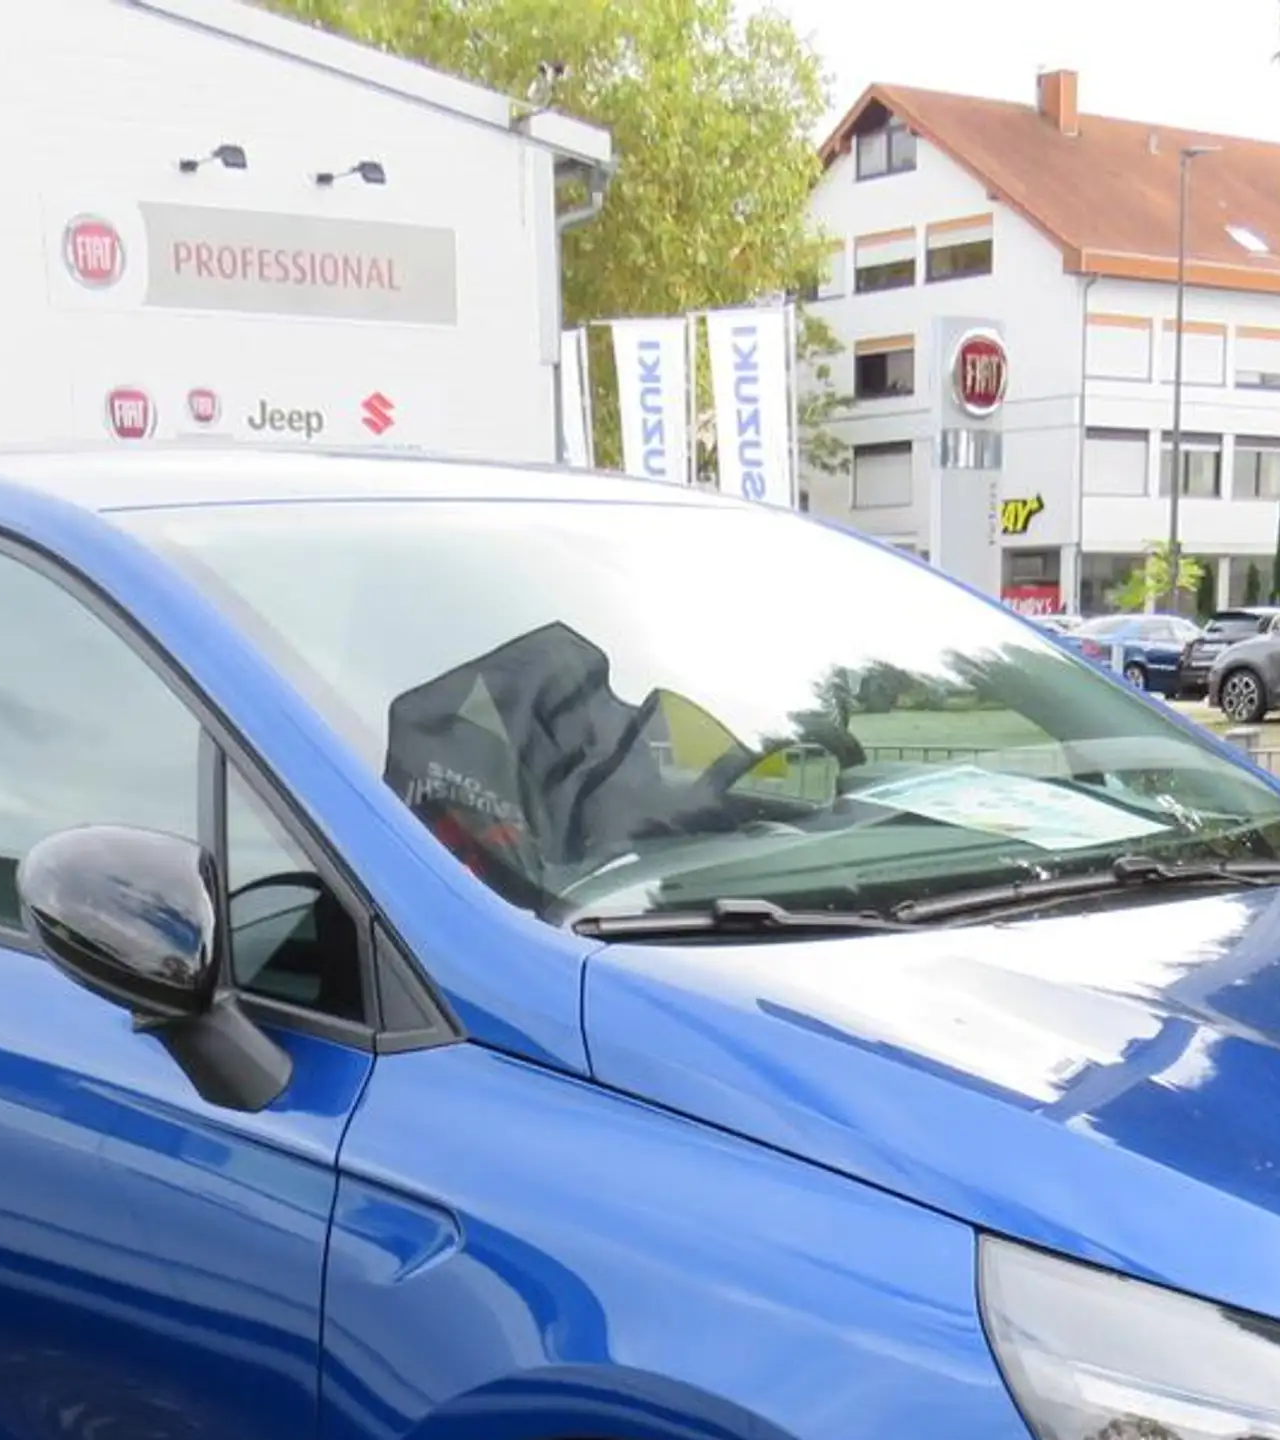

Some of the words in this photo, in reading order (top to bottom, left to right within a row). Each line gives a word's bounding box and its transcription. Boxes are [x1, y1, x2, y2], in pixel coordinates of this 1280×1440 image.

[76, 235, 112, 271] FIAT
[172, 240, 401, 291] PROFESSIONAL
[964, 353, 1001, 398] FIAT
[114, 399, 145, 428] FIAT
[247, 399, 326, 439] Jeep
